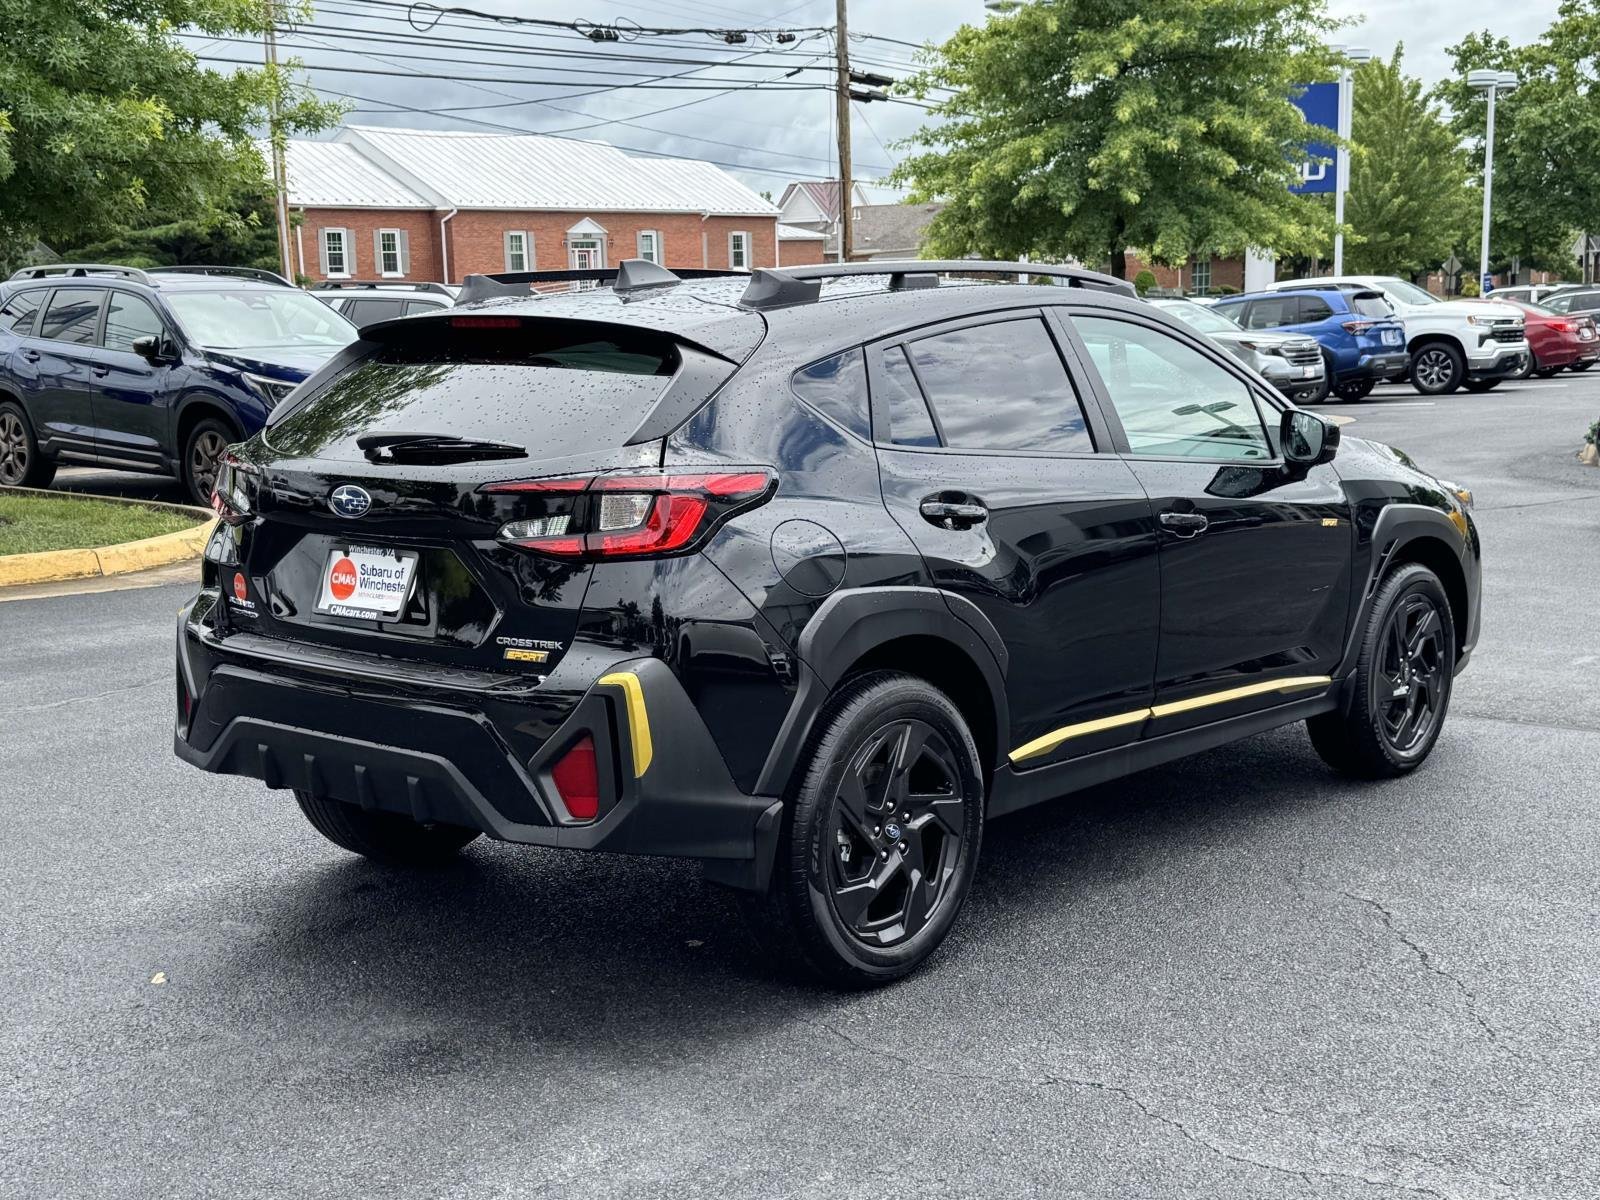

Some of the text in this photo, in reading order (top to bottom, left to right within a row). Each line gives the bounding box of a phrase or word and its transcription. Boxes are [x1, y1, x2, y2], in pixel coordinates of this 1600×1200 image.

[348, 544, 396, 557] Winchester, VA
[331, 572, 355, 585] CMA's
[360, 563, 405, 580] Subaru of
[359, 578, 405, 592] Wincheste
[330, 605, 377, 619] CMAcars.com
[496, 636, 563, 650] CROSSTREK
[506, 650, 546, 662] SPORT
